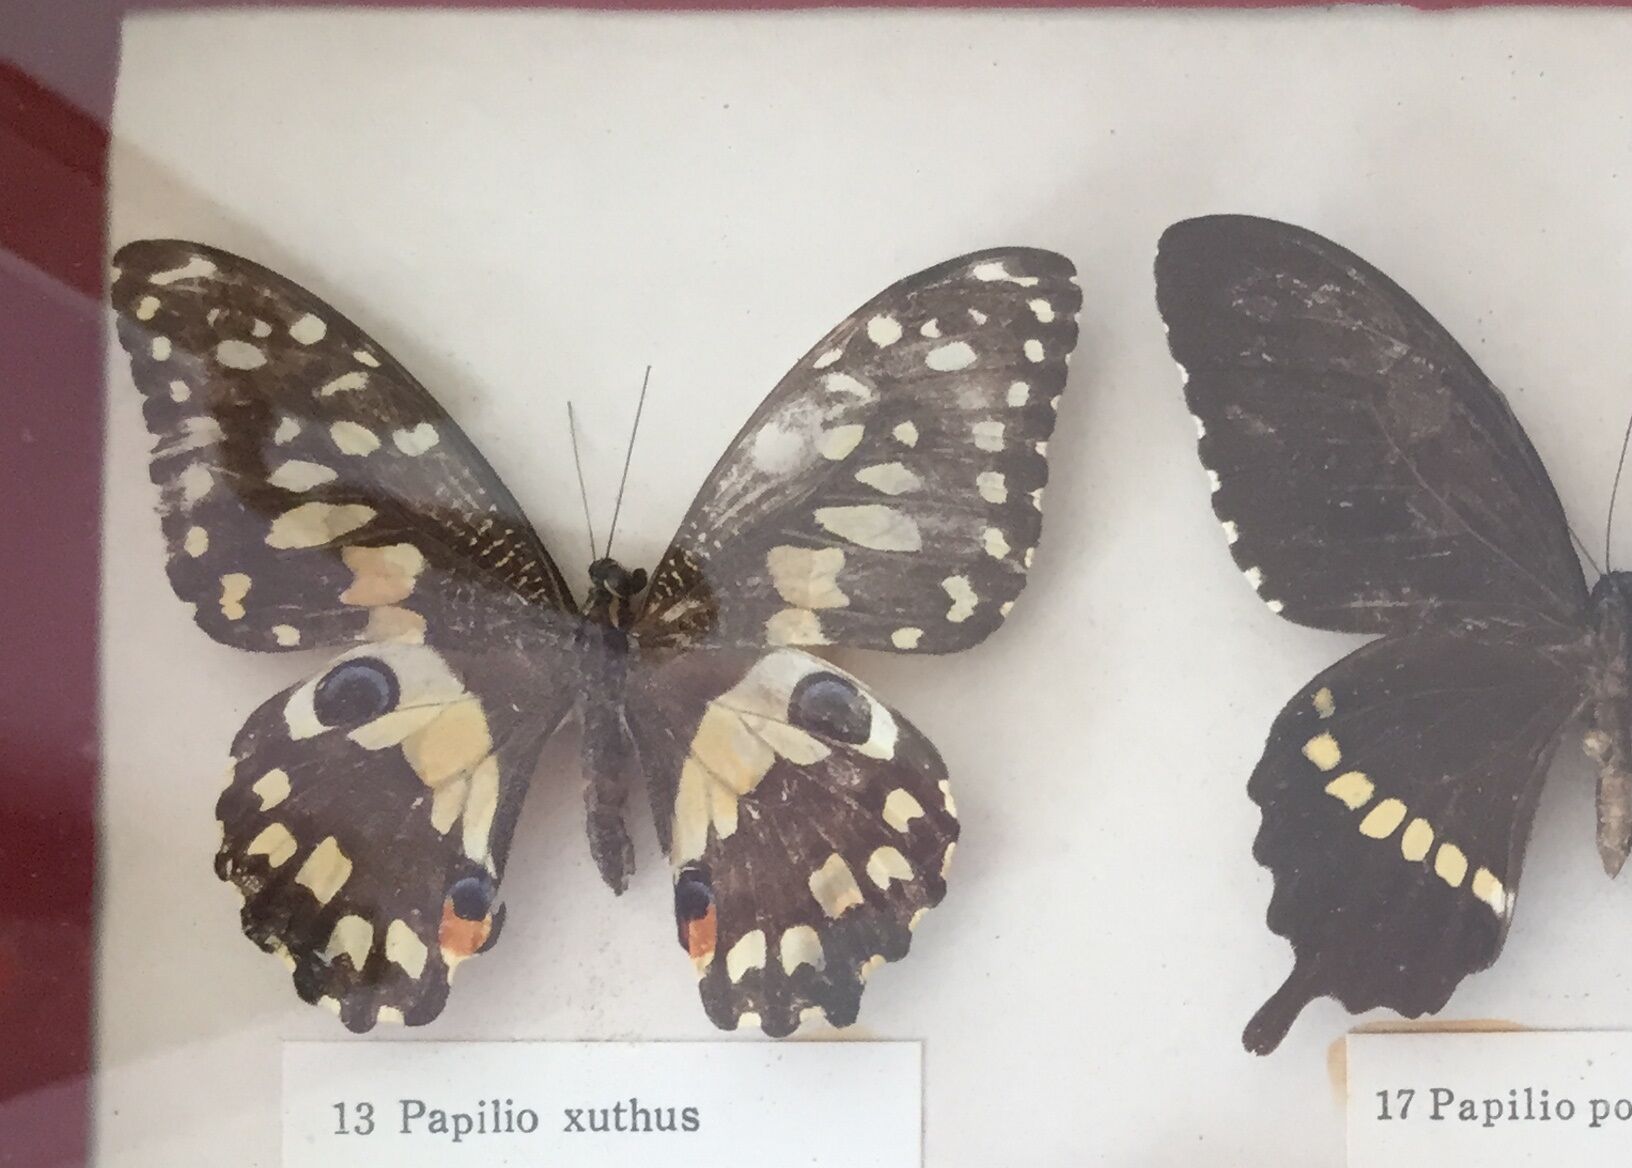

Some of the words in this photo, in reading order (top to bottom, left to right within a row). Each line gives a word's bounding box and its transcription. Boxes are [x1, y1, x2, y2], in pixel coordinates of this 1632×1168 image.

[332, 1101, 376, 1136] 13
[398, 1098, 540, 1142] Papilio
[562, 1097, 701, 1133] xuthus
[1375, 1089, 1415, 1121] 17
[1428, 1086, 1576, 1128] Papilio
